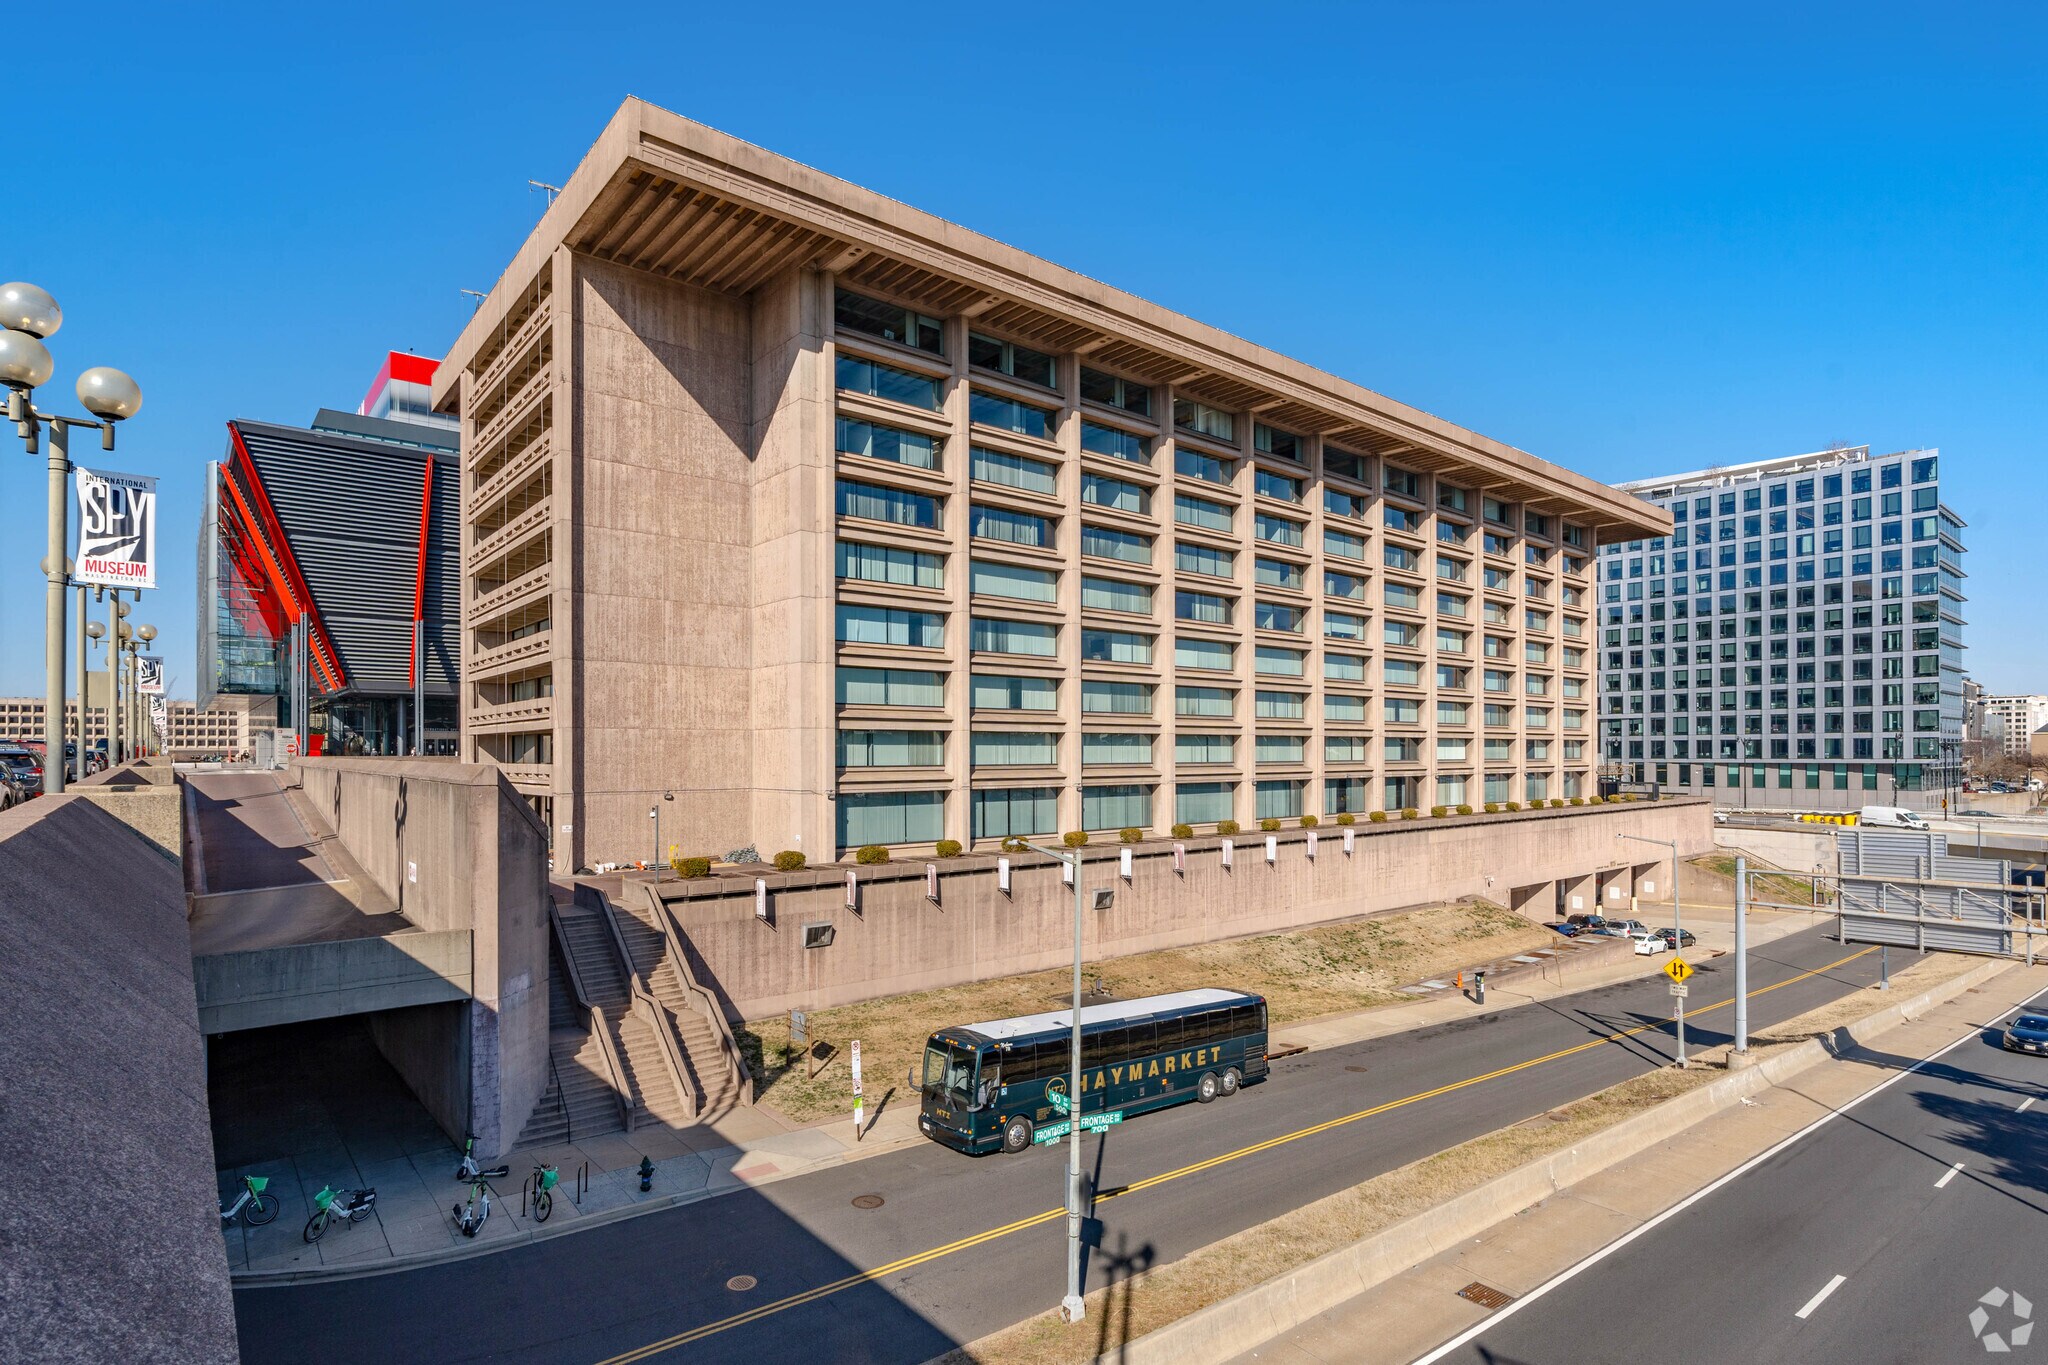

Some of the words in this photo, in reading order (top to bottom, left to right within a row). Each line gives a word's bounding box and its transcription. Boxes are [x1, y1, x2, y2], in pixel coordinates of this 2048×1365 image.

[85, 474, 148, 489] INTERNATIONAL
[85, 482, 148, 537] SPY
[85, 559, 147, 577] MUSEUM
[85, 573, 134, 582] WASHINGTON
[141, 660, 161, 677] SPY
[1080, 1046, 1221, 1093] HAYMARKET
[1051, 1093, 1061, 1104] 10
[1055, 1104, 1067, 1115] 500
[1081, 1114, 1114, 1127] FRONTAGE
[1036, 1124, 1065, 1142] FRONTAGE
[1092, 1125, 1109, 1134] 700
[1045, 1136, 1060, 1147] 1000
